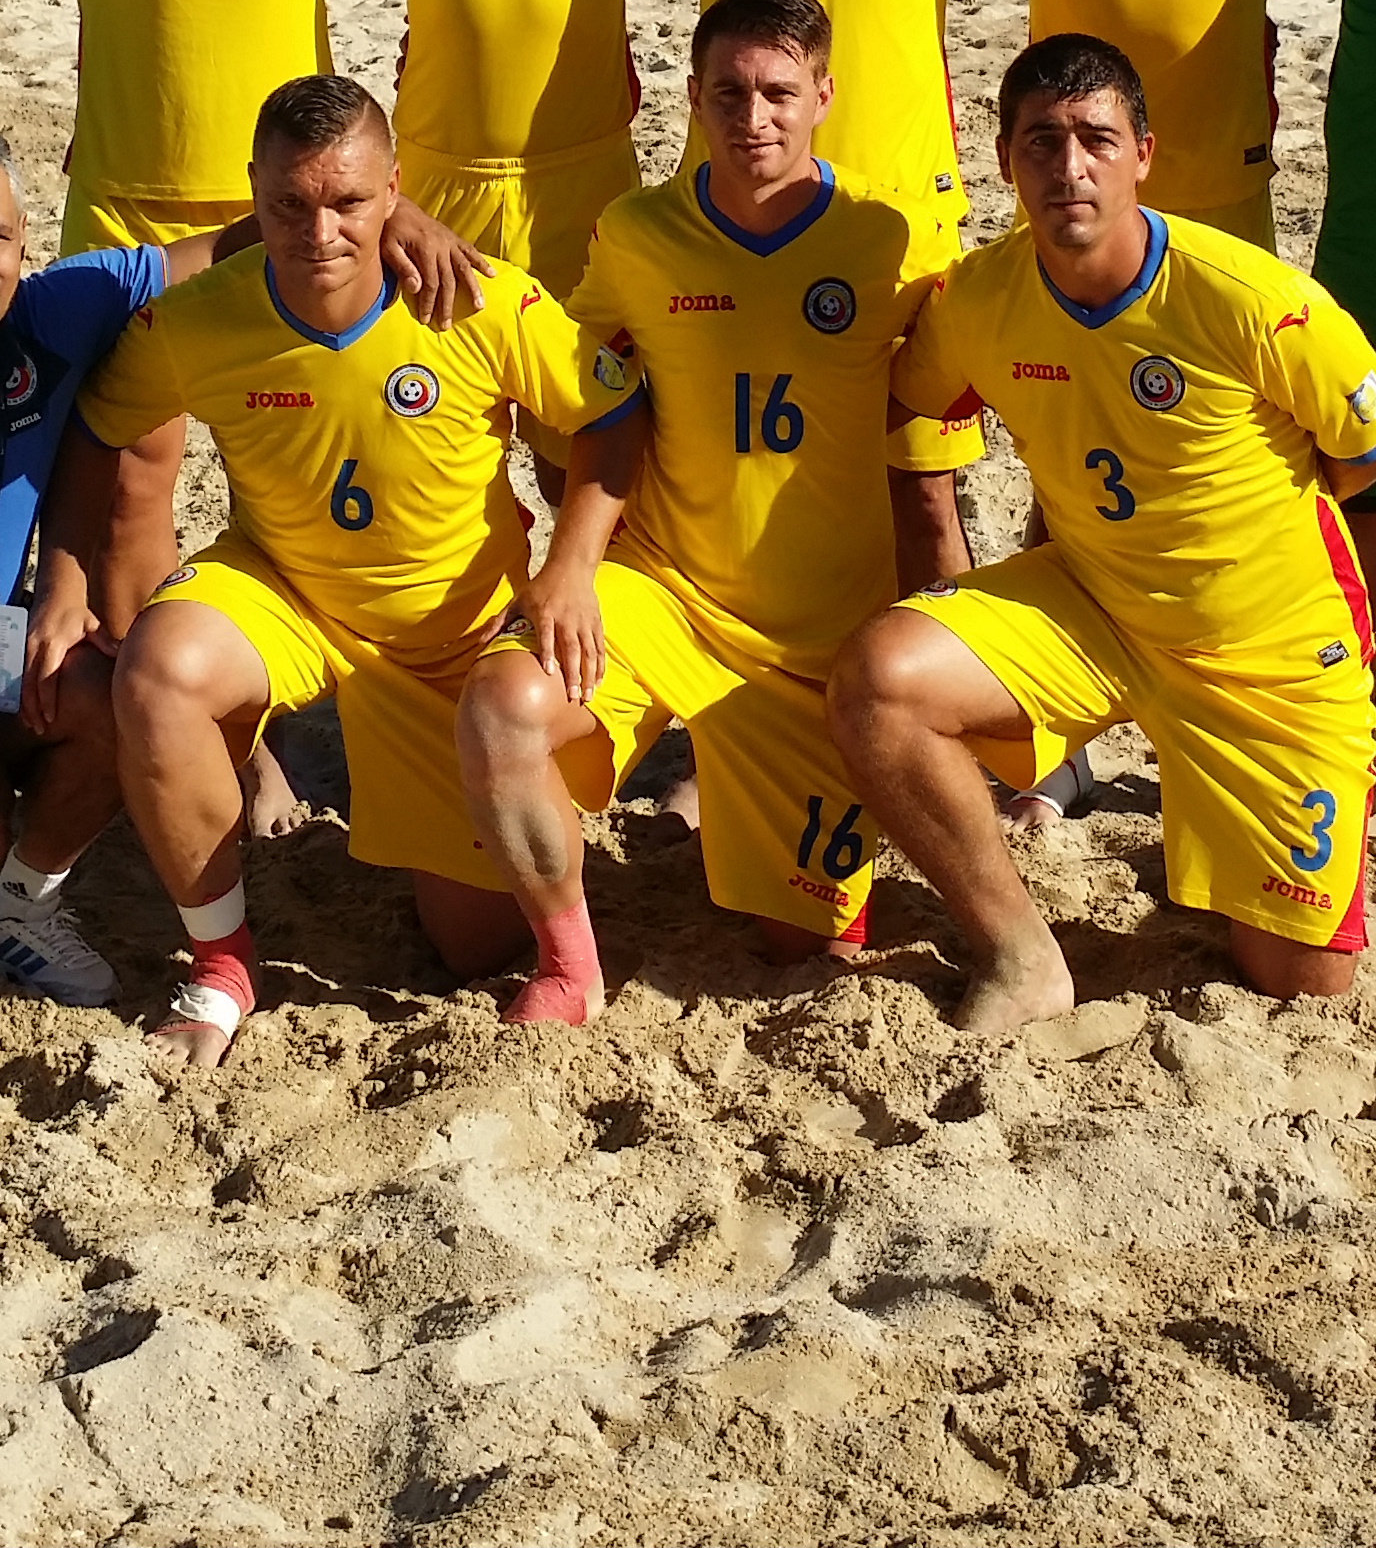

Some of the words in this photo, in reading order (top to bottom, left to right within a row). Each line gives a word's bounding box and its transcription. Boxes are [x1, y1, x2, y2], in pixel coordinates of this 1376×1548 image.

[734, 372, 804, 454] 16
[330, 459, 374, 531] 6
[1085, 448, 1135, 521] 3
[797, 794, 863, 880] 16
[1290, 789, 1337, 872] 3
